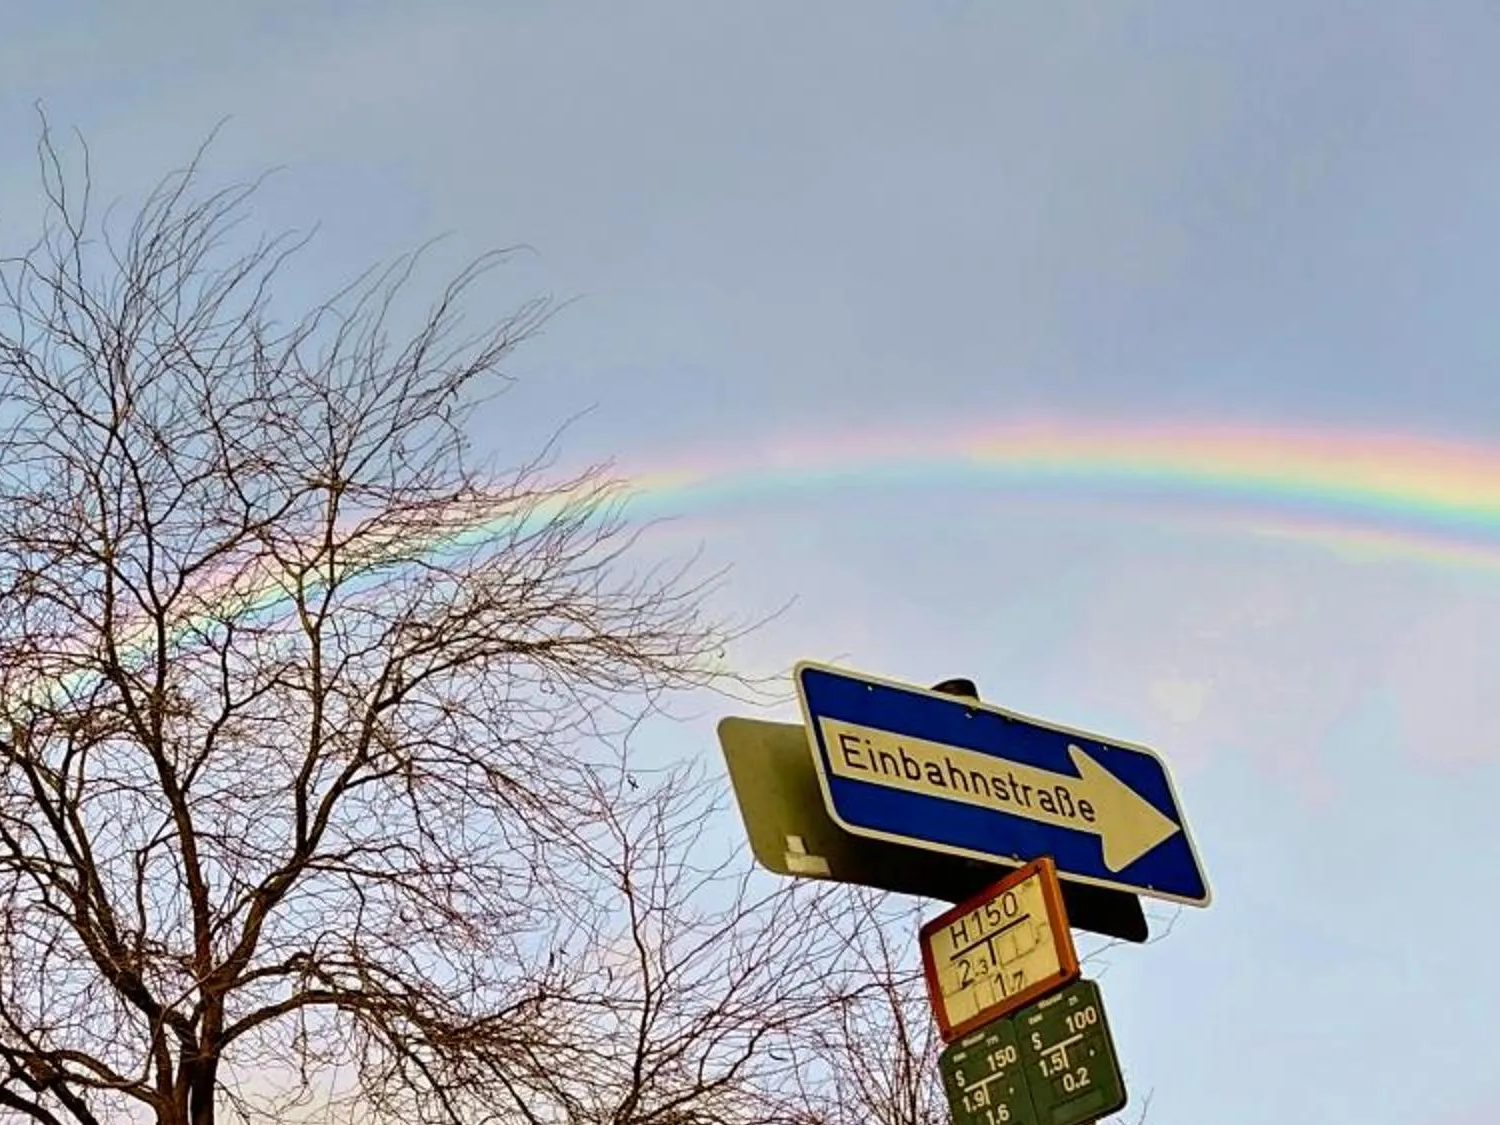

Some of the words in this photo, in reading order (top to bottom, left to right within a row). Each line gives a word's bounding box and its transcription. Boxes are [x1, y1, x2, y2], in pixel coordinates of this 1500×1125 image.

[838, 733, 1096, 822] Einbahnstraße
[958, 959, 988, 990] 2.3
[1031, 1031, 1043, 1051] S
[1065, 1005, 1097, 1033] 100
[955, 1069, 965, 1088] S
[987, 1045, 1017, 1071] 150
[1039, 1051, 1063, 1077] 1.5
[1063, 1066, 1091, 1093] 0.2
[963, 1089, 985, 1113] 1.9
